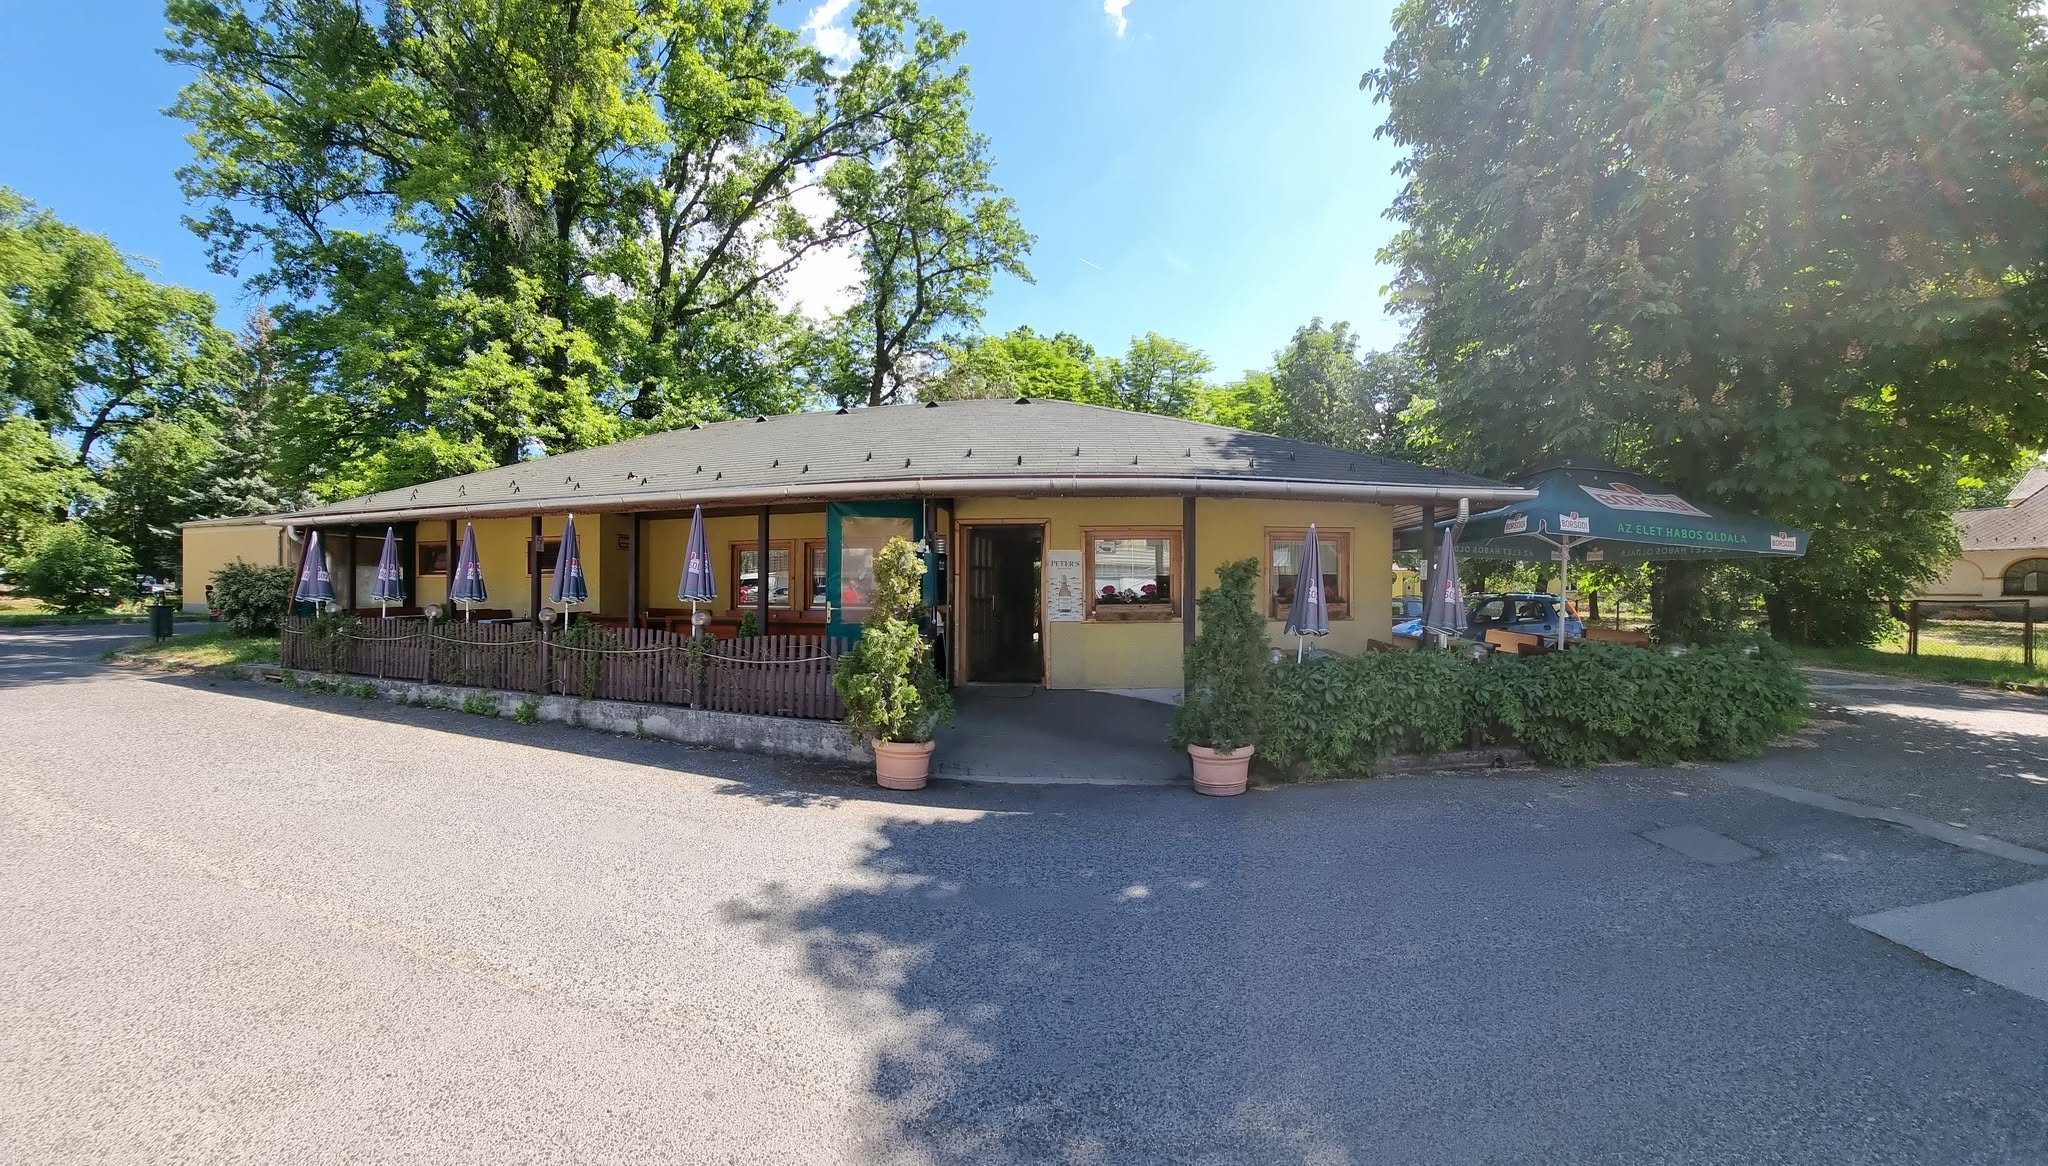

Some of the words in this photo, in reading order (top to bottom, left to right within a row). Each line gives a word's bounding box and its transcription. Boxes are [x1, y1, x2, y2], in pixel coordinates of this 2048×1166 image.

[1561, 519, 1588, 530] BORSODI
[1617, 523, 1632, 533] AZ
[1636, 521, 1662, 537] ÉLET
[1666, 527, 1703, 540] HABOS
[1707, 531, 1747, 544] OLDALA
[1772, 539, 1796, 548] BORSODI
